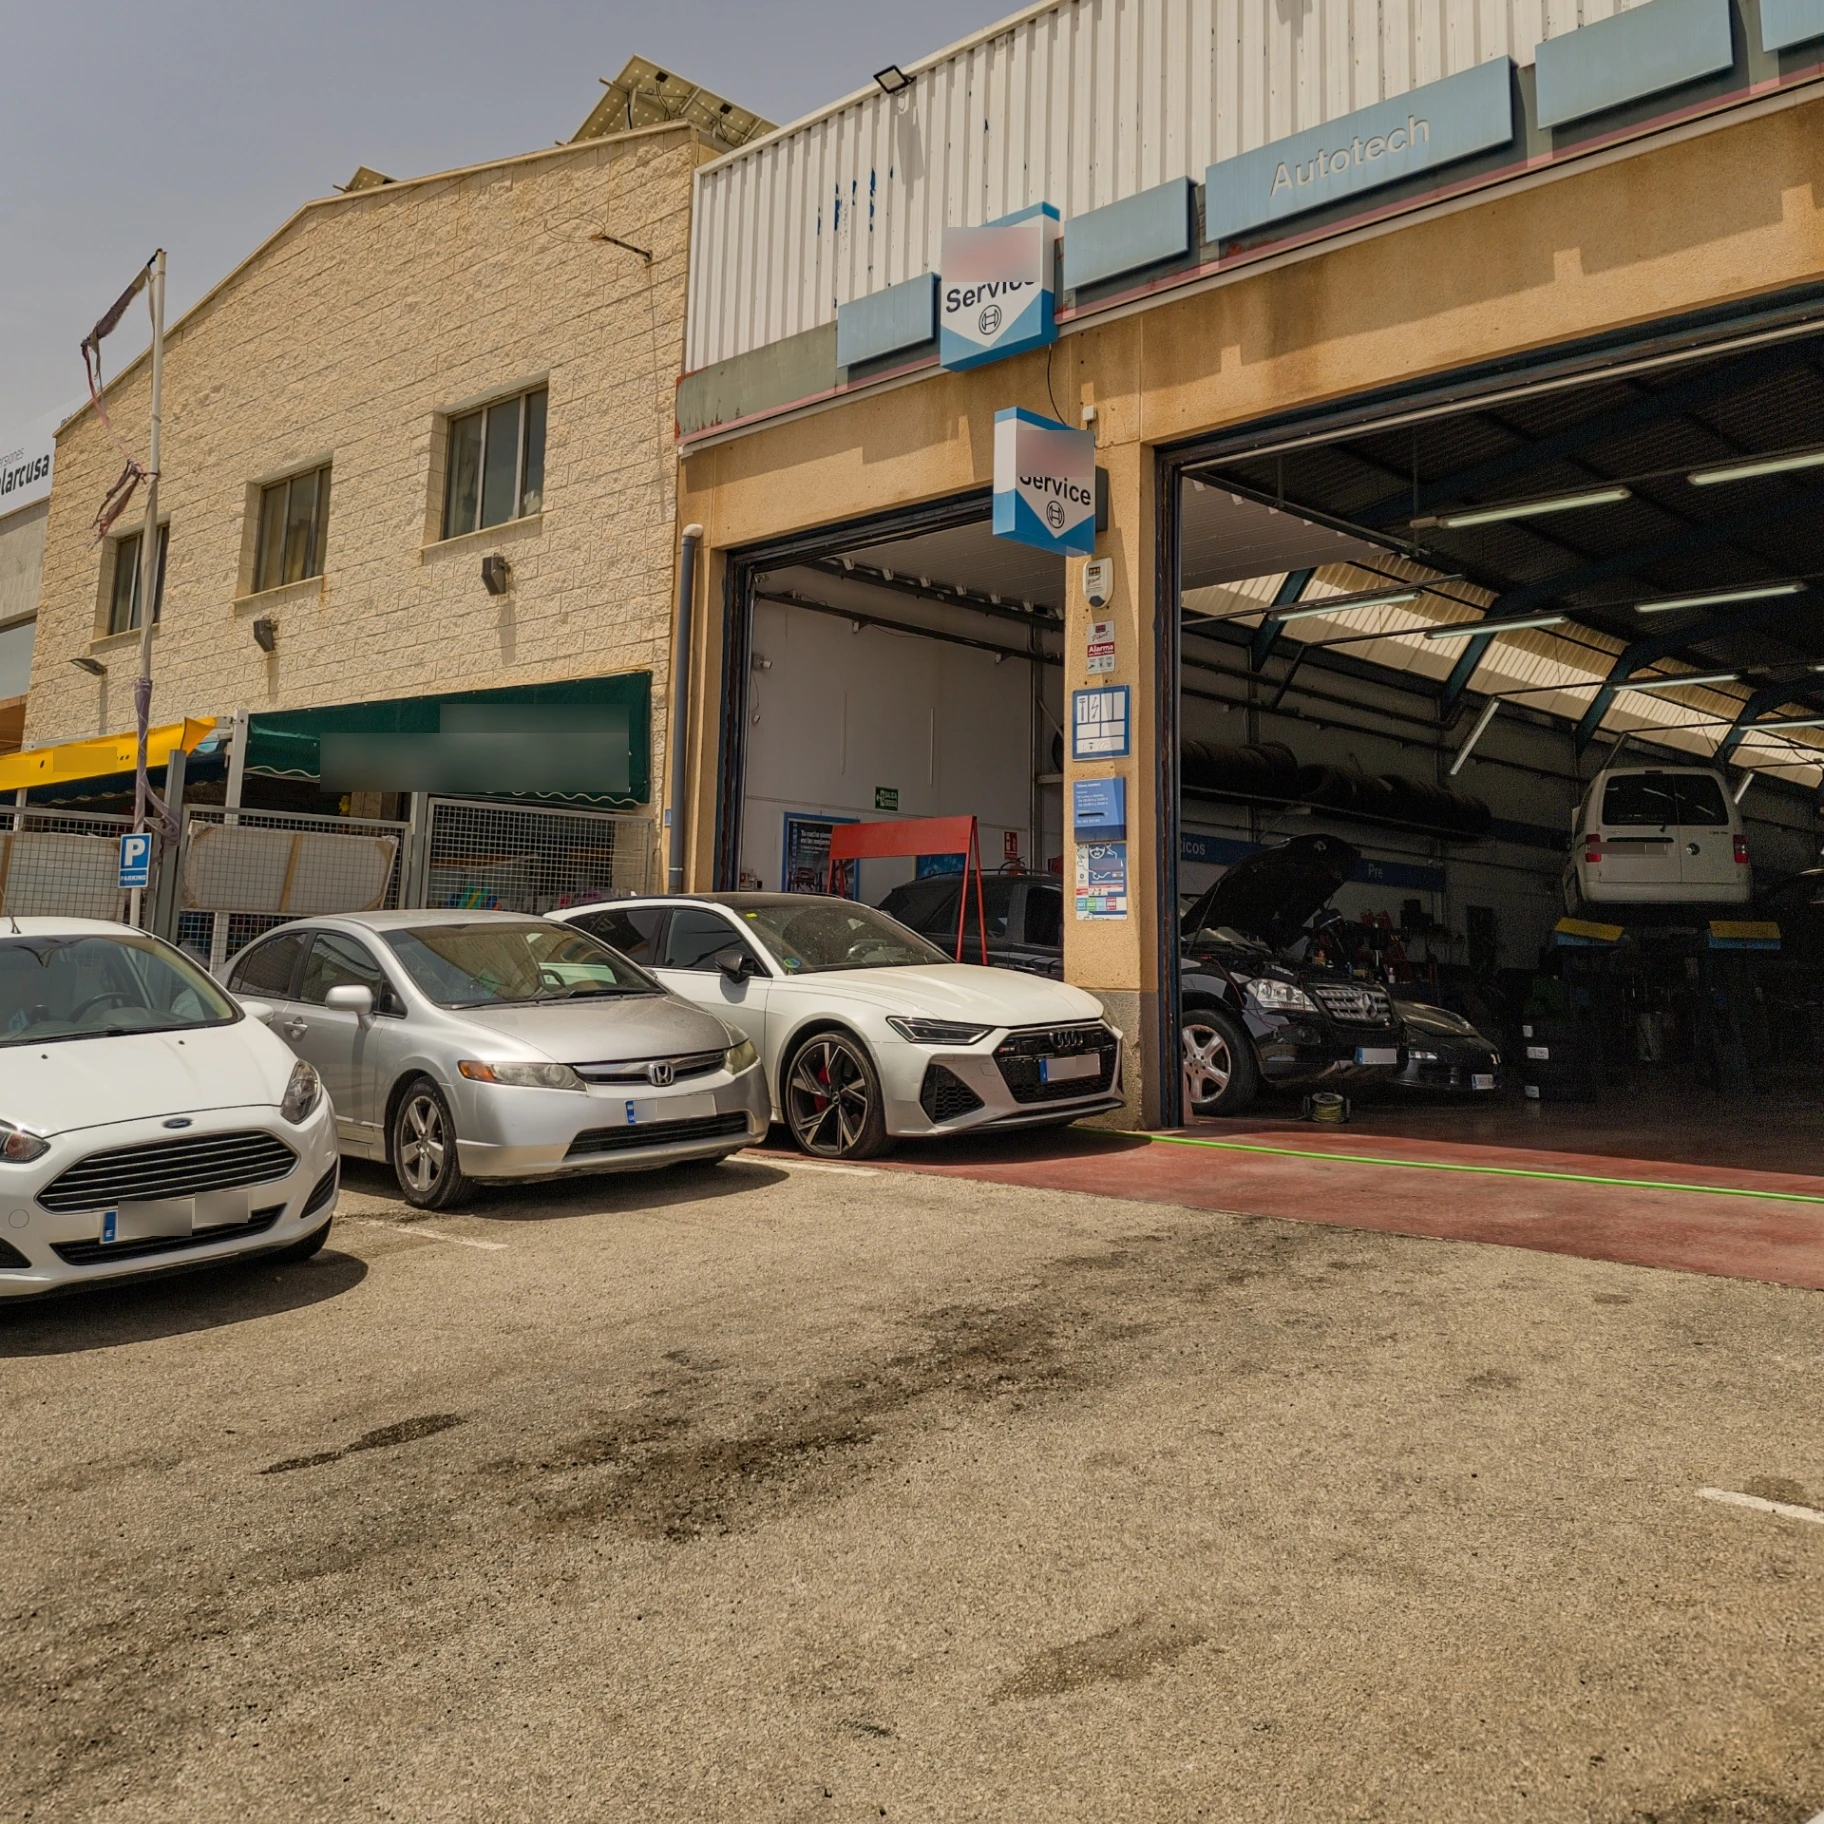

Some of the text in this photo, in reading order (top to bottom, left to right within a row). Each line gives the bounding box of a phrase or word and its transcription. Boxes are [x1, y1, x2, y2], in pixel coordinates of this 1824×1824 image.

[1270, 114, 1431, 197] Autotech
[945, 281, 1036, 313] Servic
[1088, 644, 1114, 652] Alarma
[124, 838, 146, 866] P
[1182, 837, 1206, 856] icos
